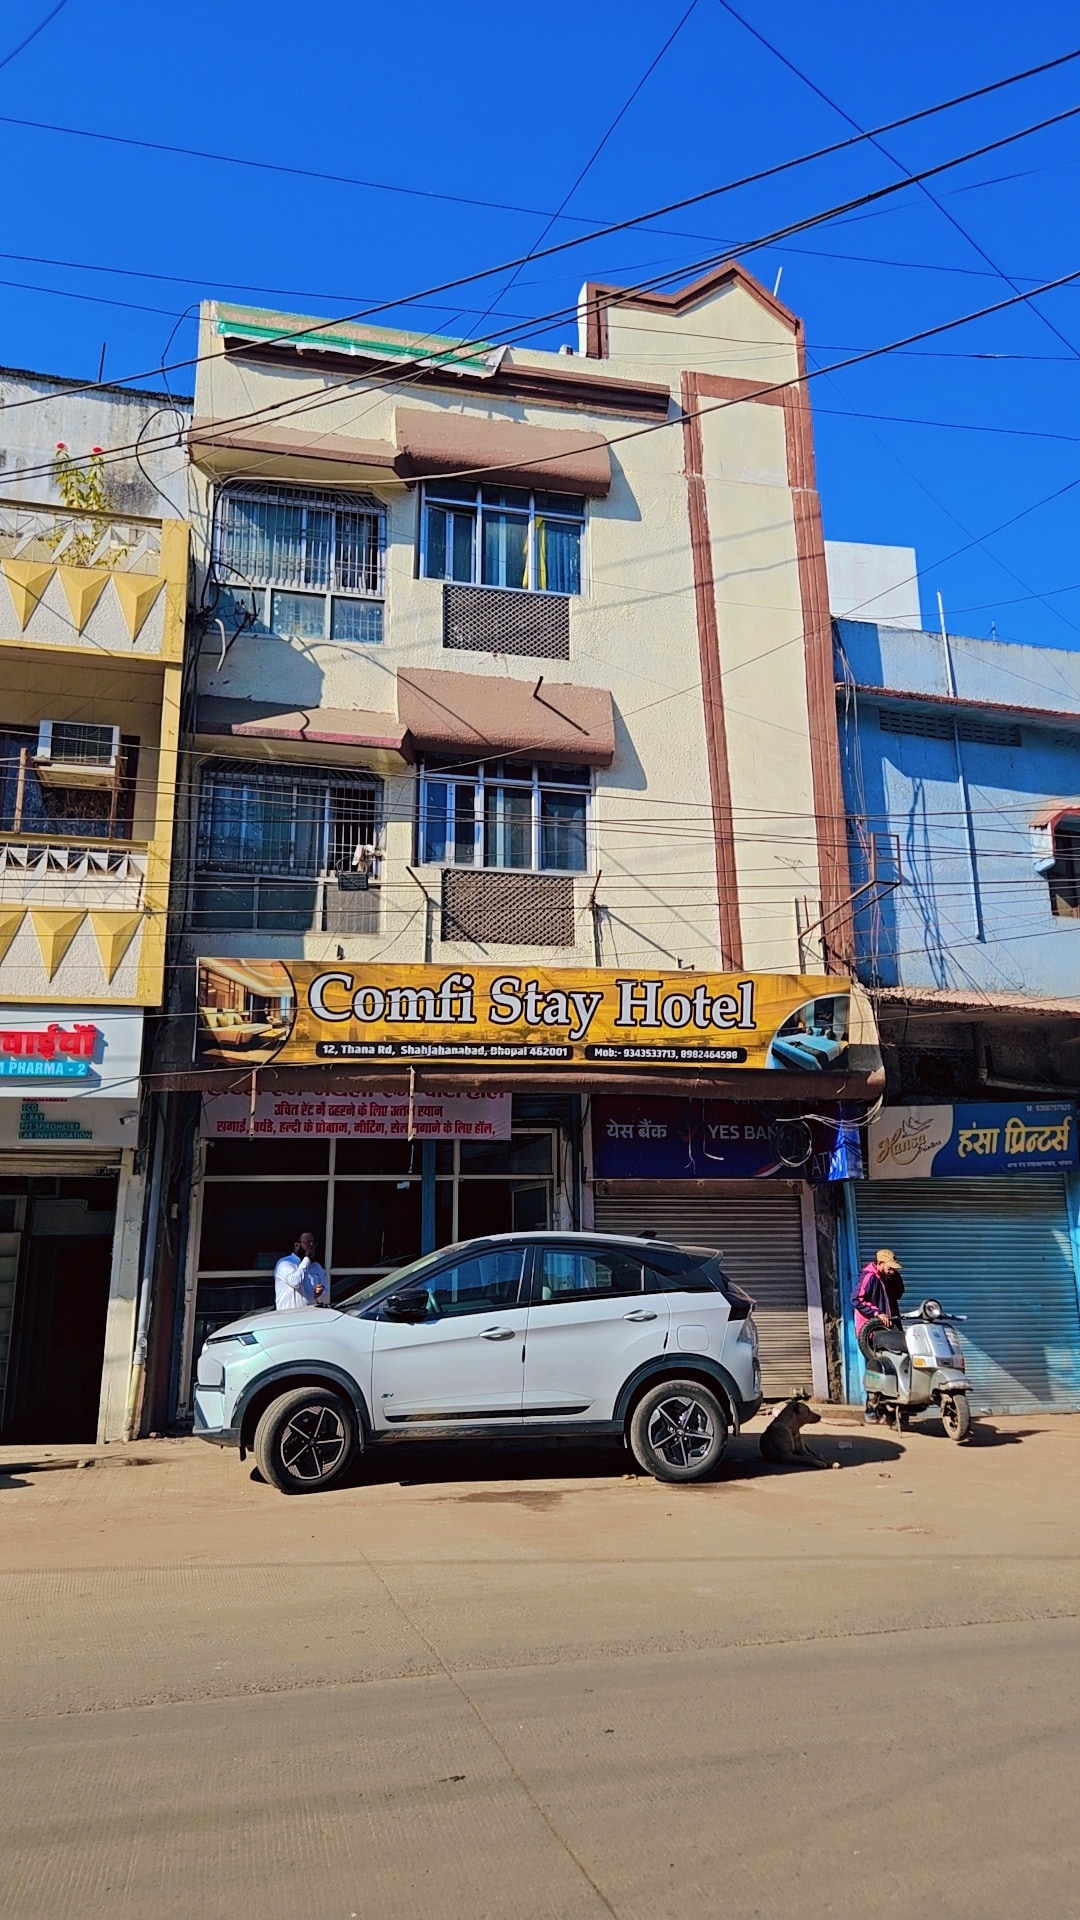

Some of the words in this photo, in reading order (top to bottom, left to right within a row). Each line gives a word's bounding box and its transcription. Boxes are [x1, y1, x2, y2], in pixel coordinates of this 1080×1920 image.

[308, 972, 475, 1023] Comfi
[489, 975, 602, 1040] Stay
[615, 979, 756, 1029] Hotel
[0, 1024, 97, 1060] वाईयाँ
[322, 1044, 338, 1055] 12,
[340, 1045, 375, 1055] Thana
[377, 1045, 396, 1056] Rd,
[400, 1045, 487, 1057] Shahjahanabad,
[490, 1046, 527, 1057] Bhopal
[529, 1047, 568, 1057] 462001
[594, 1048, 621, 1058] Mob:-
[623, 1049, 679, 1060] 9343533713,
[680, 1050, 738, 1060] 8982464598
[9, 1061, 63, 1075] PHARMA
[77, 1063, 86, 1074] 2
[274, 1101, 298, 1116] उचित
[328, 1102, 356, 1117] ठहरने
[358, 1102, 368, 1117] के
[370, 1102, 388, 1117] लिए
[303, 1119, 314, 1134] के
[443, 1120, 453, 1134] के
[455, 1120, 473, 1134] लिए
[606, 1117, 634, 1139] येस
[637, 1117, 667, 1139] बैंक
[708, 1124, 740, 1140] YES
[744, 1125, 782, 1140] BAN
[958, 1121, 1000, 1158] हंसा
[1004, 1115, 1073, 1155] प्रिन्टर्स
[876, 1128, 926, 1164] Hansa
